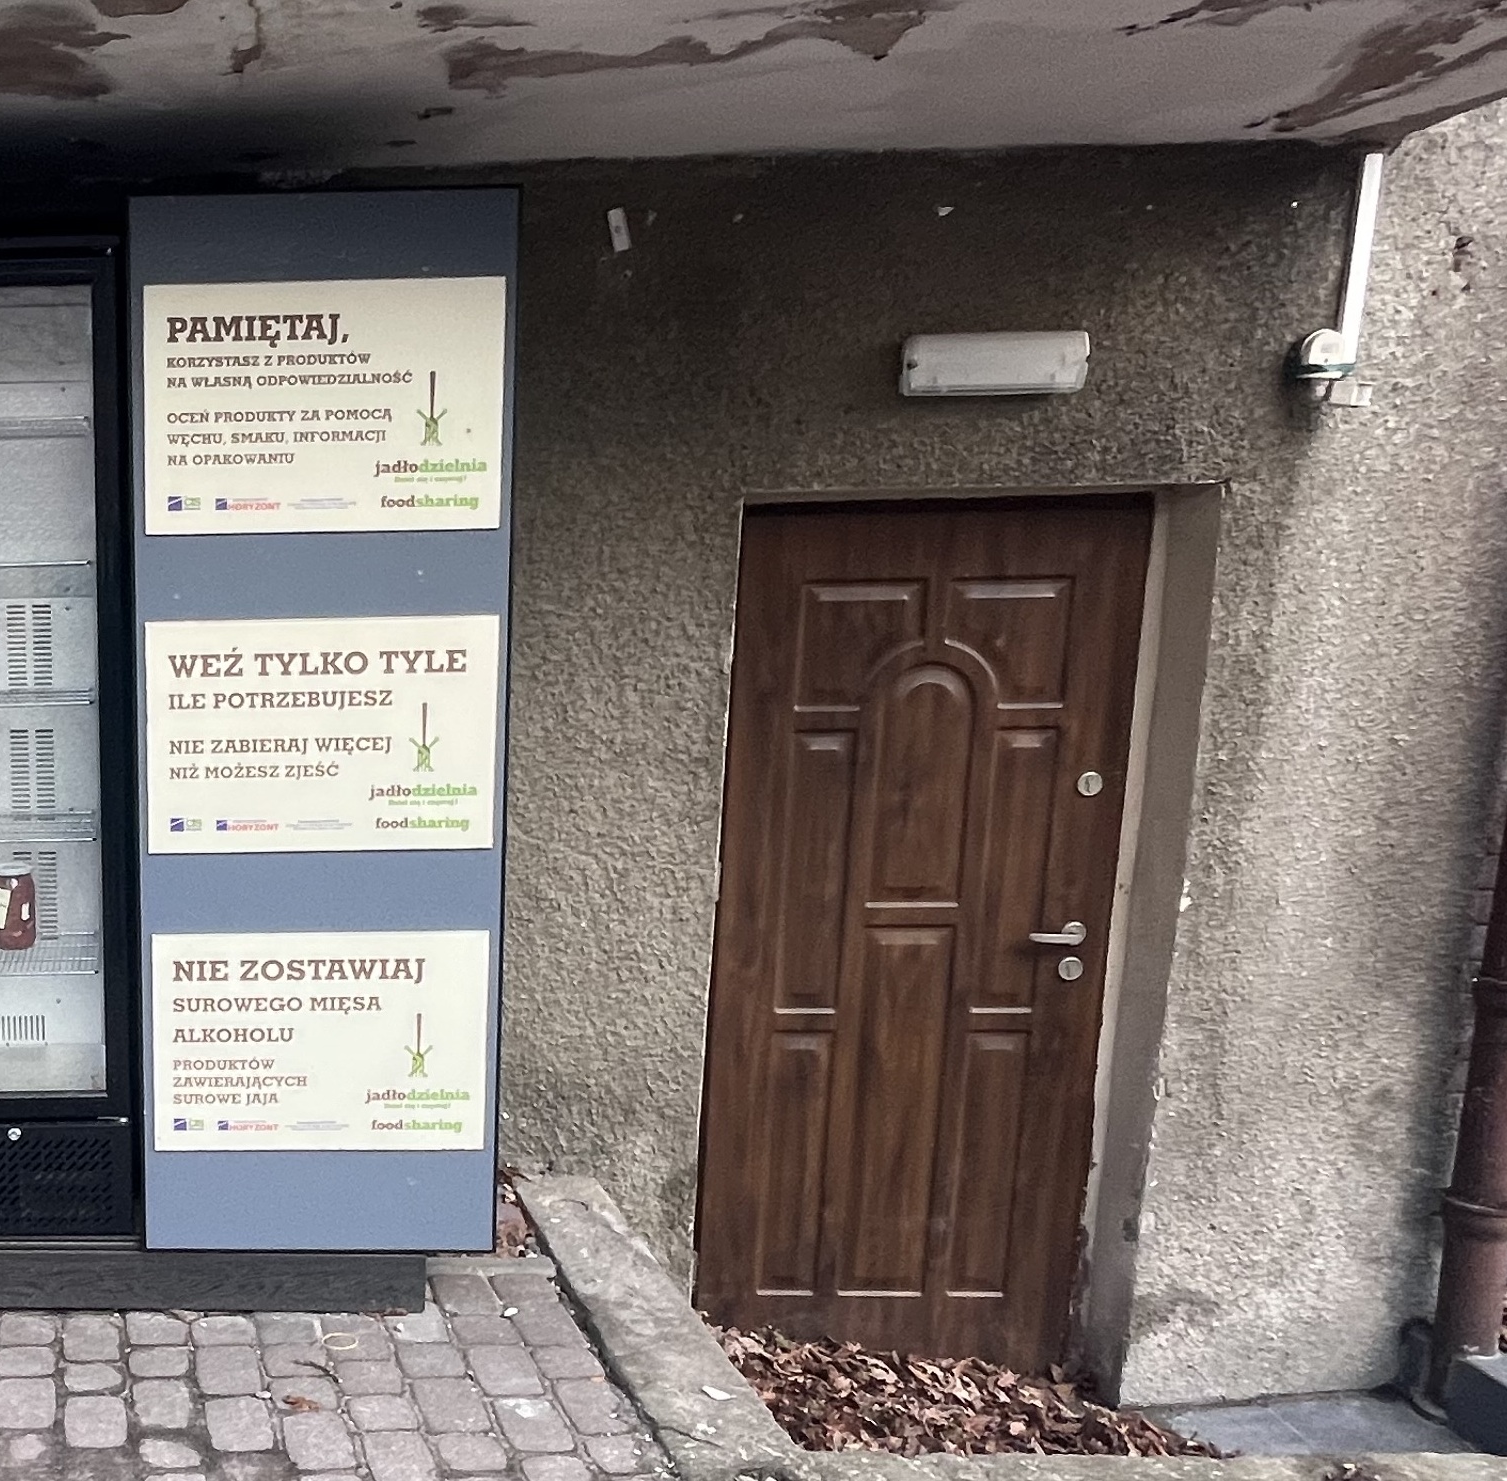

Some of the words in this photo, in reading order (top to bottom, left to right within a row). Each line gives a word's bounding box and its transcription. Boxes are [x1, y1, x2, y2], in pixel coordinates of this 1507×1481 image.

[166, 313, 350, 348] PAMIĘTAJ,
[166, 356, 260, 369] KORZYSTASZ
[264, 356, 273, 366] Z
[277, 351, 371, 366] PRODUKTÓW
[166, 377, 187, 388] NA
[191, 376, 252, 389] WŁASNĄ
[256, 370, 413, 387] ODPOWIEDZIALNOŚĆ
[167, 410, 210, 424] OCEŃ
[214, 410, 296, 423] PRODUKTY
[301, 410, 321, 421] ZA
[325, 409, 392, 422] POMOCĄ
[167, 433, 226, 446] WĘCHU,
[230, 432, 289, 444] SMAKU,
[293, 430, 386, 443] INFORMACJI
[167, 454, 188, 466] NA
[192, 453, 295, 465] OPAKOWANIU
[374, 459, 488, 477] jadłodzielnia
[380, 494, 479, 509] foodsharing
[168, 647, 244, 678] WEŹ
[254, 652, 369, 676] TYLKO
[380, 649, 468, 674] TYLE
[168, 693, 206, 710] ILE
[213, 690, 393, 710] POTRZEBUJESZ
[168, 740, 204, 755] NIE
[211, 738, 308, 754] ZABIERAJ
[315, 737, 392, 755] WIĘCEJ
[168, 764, 199, 779] NIŻ
[205, 763, 280, 778] MOŻESZ
[285, 760, 339, 779] ZJEŚĆ
[369, 784, 477, 800] jadłodzielnia
[375, 817, 470, 832] foodsharing
[172, 960, 229, 982] NIE
[240, 958, 426, 984] ZOSTAWIAJ
[172, 997, 303, 1013] SUROWEGO
[309, 996, 382, 1014] MIĘSA
[172, 1028, 294, 1043] ALKOHOLU
[172, 1056, 275, 1070] PRODUKTÓW
[172, 1076, 308, 1090] ZAWIERAJĄCYCH
[172, 1093, 242, 1105] SUROWE
[245, 1093, 279, 1106] JAJA
[365, 1089, 470, 1104] jadłodzielnia
[371, 1118, 463, 1133] foodsharing
